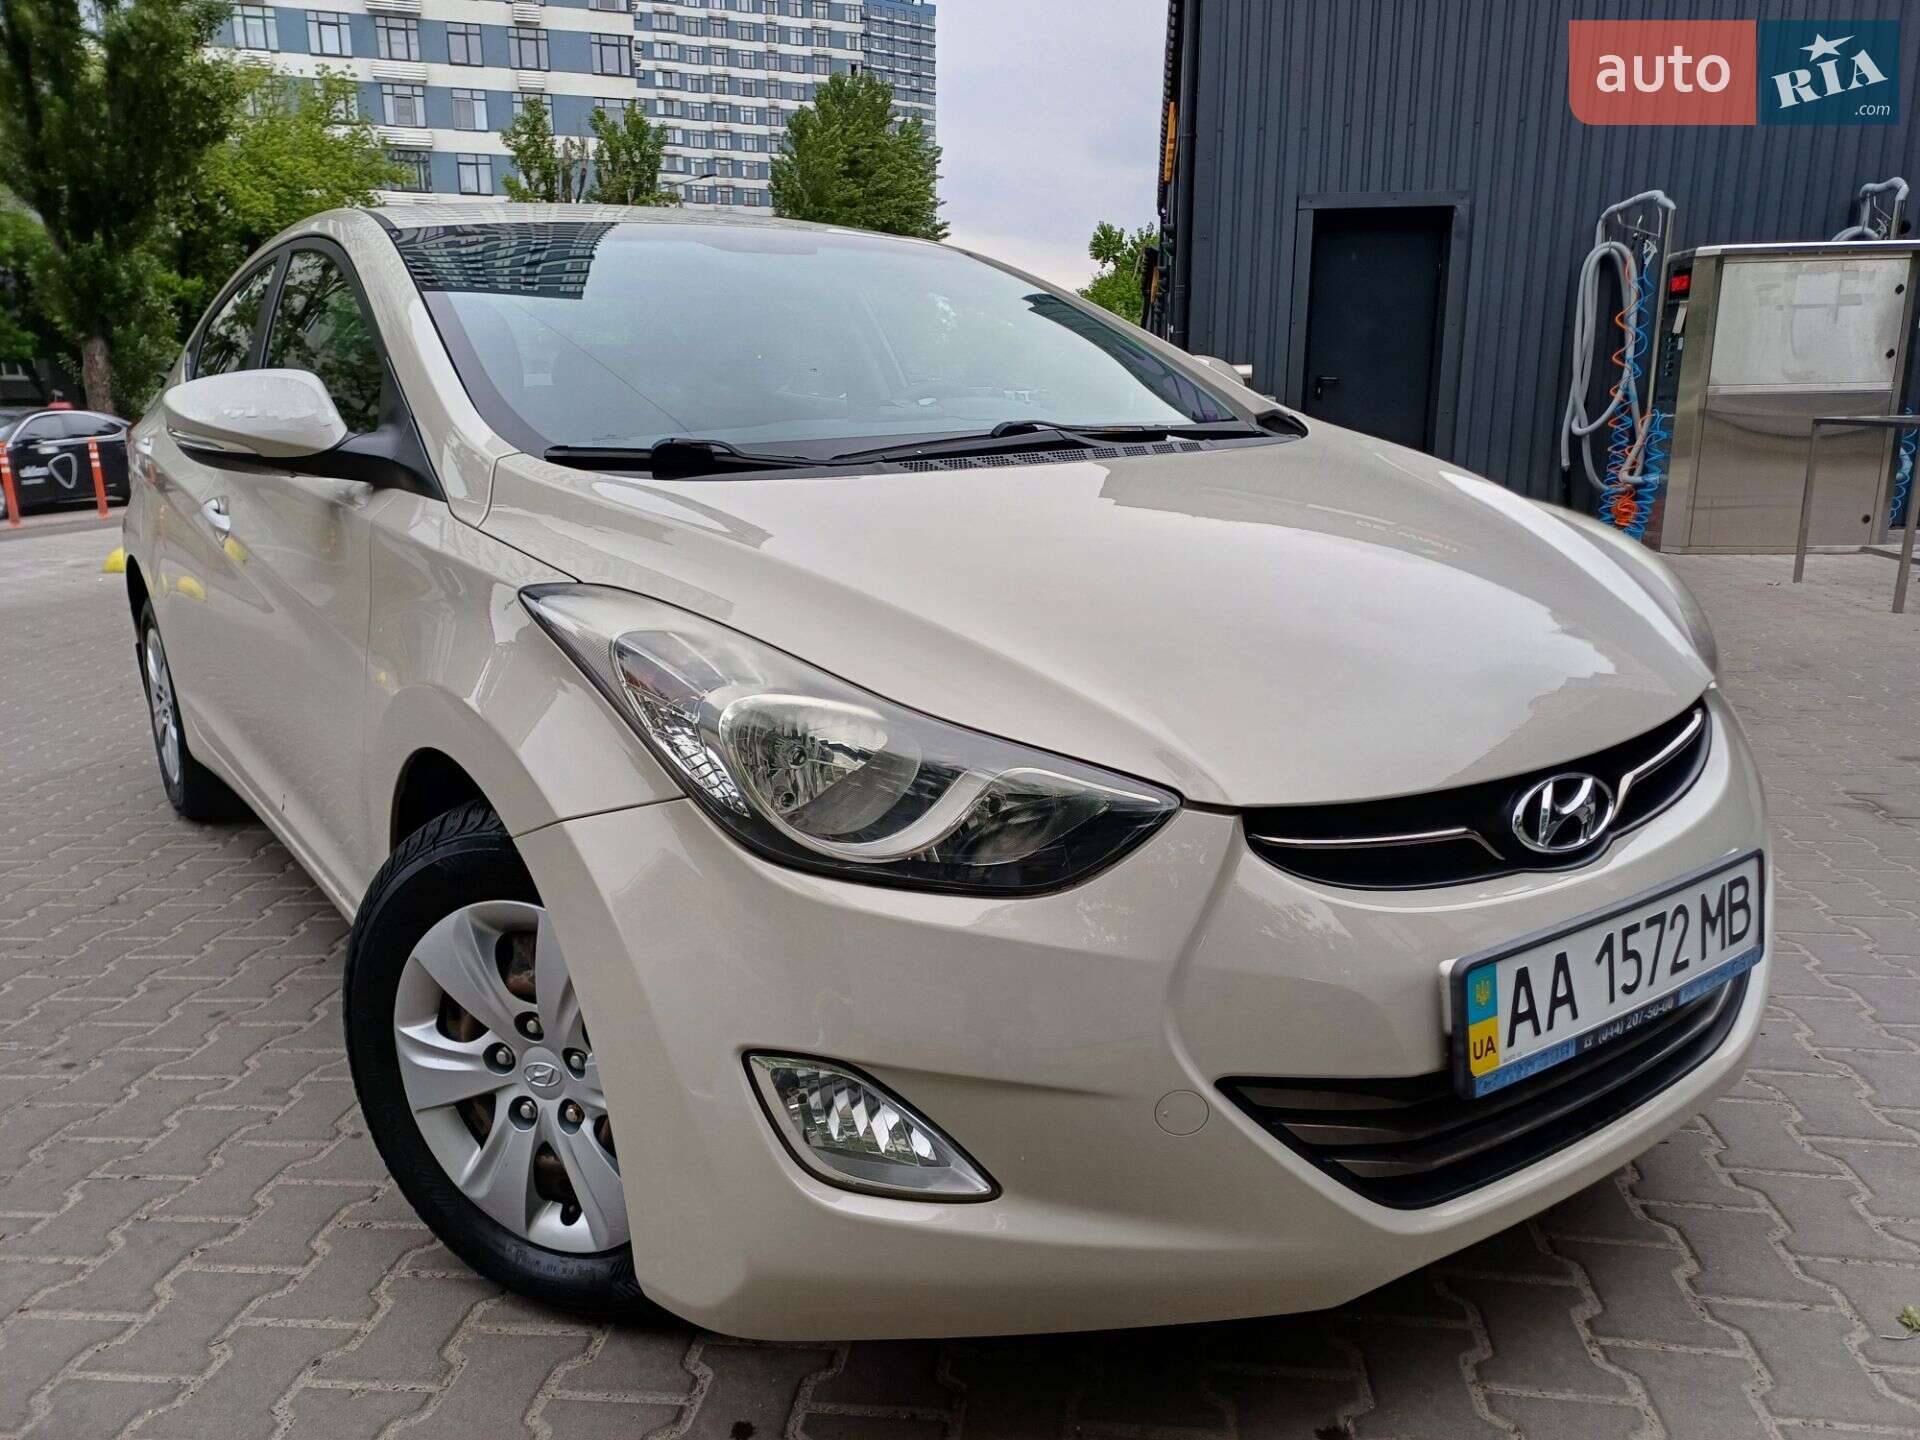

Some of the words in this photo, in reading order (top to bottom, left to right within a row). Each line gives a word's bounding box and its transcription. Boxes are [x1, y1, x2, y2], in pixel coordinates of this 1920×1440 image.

[1507, 951, 1579, 1048] AA
[1595, 904, 1690, 1004] 1572
[1700, 875, 1751, 961] MB
[1473, 1035, 1496, 1060] UA
